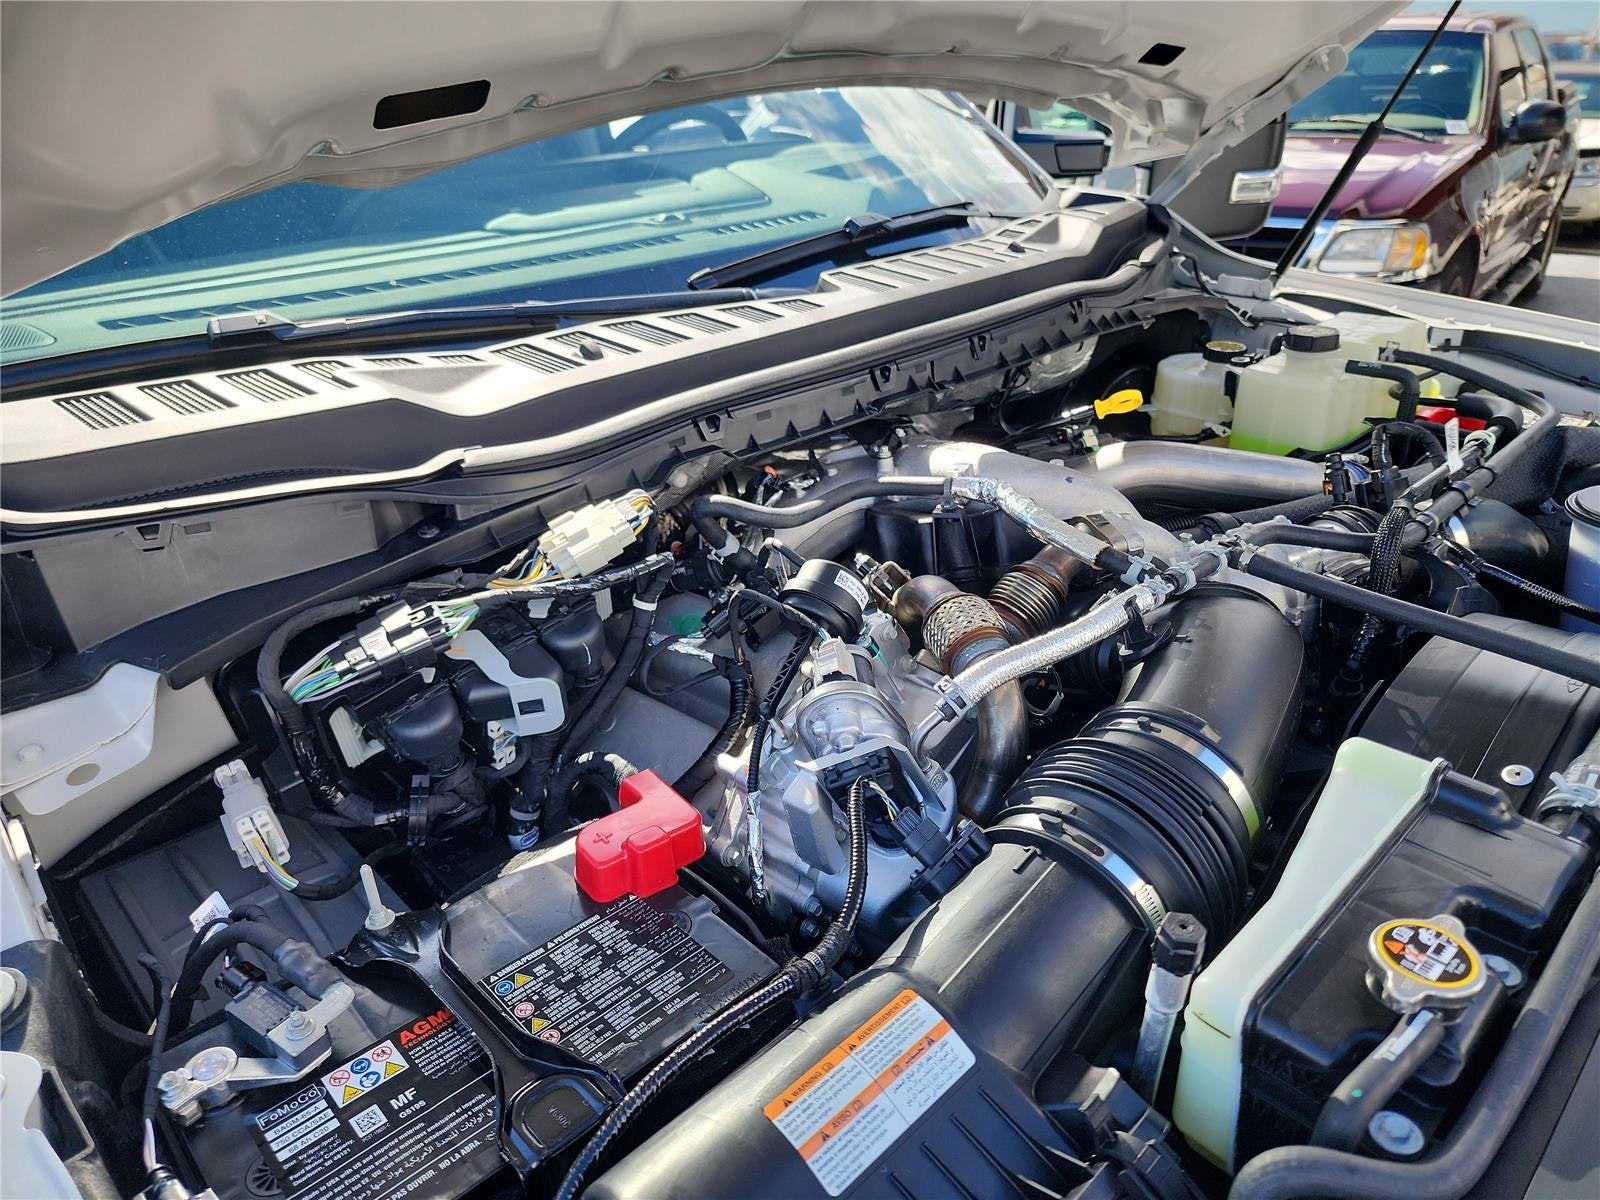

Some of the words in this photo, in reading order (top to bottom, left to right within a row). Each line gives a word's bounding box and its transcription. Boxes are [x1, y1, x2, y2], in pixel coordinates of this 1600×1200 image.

[497, 947, 544, 977] DANGER/POISON
[400, 1009, 452, 1044] AGM
[857, 1002, 901, 1041] AVERTISSEMENT
[390, 1087, 416, 1109] MF
[791, 1071, 822, 1097] WARNING
[259, 1089, 316, 1126] FoMoCo
[274, 1106, 319, 1135] BAGM-65-A
[830, 1108, 852, 1129] AVISO
[275, 1135, 291, 1147] 750
[291, 1111, 330, 1137] CCA/SAE
[407, 1169, 437, 1191] OUVRIR.
